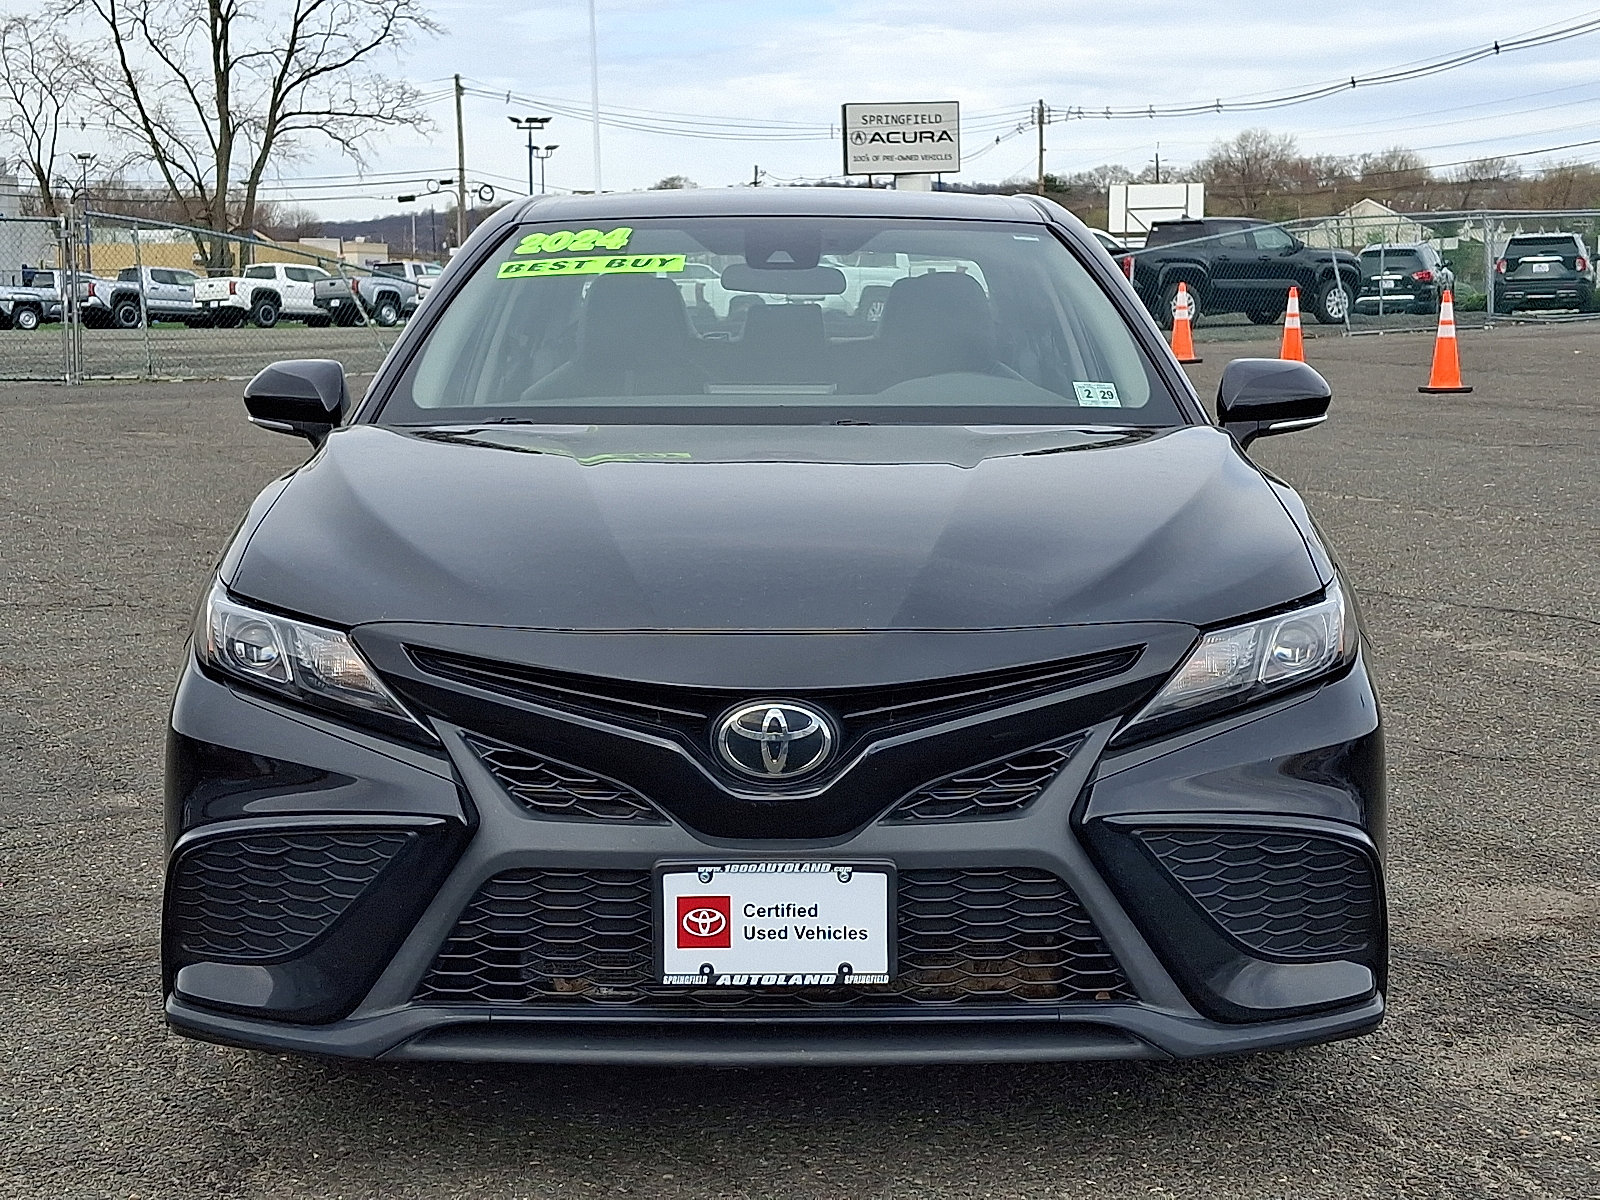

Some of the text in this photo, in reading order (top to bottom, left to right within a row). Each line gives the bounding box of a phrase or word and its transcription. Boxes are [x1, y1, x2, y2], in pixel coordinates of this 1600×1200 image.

[861, 114, 942, 125] SPRINGFIELD
[869, 130, 954, 144] ACURA
[872, 154, 879, 162] OF
[921, 153, 952, 161] VEHICLES
[514, 227, 632, 255] 2024
[502, 258, 676, 274] BEST BUY
[1084, 389, 1114, 399] 2 29
[743, 903, 818, 918] Certified
[743, 926, 868, 940] Used Vehicles
[663, 974, 889, 985] SPRINGFIELD AUTOLAND SPRINGFIELD
